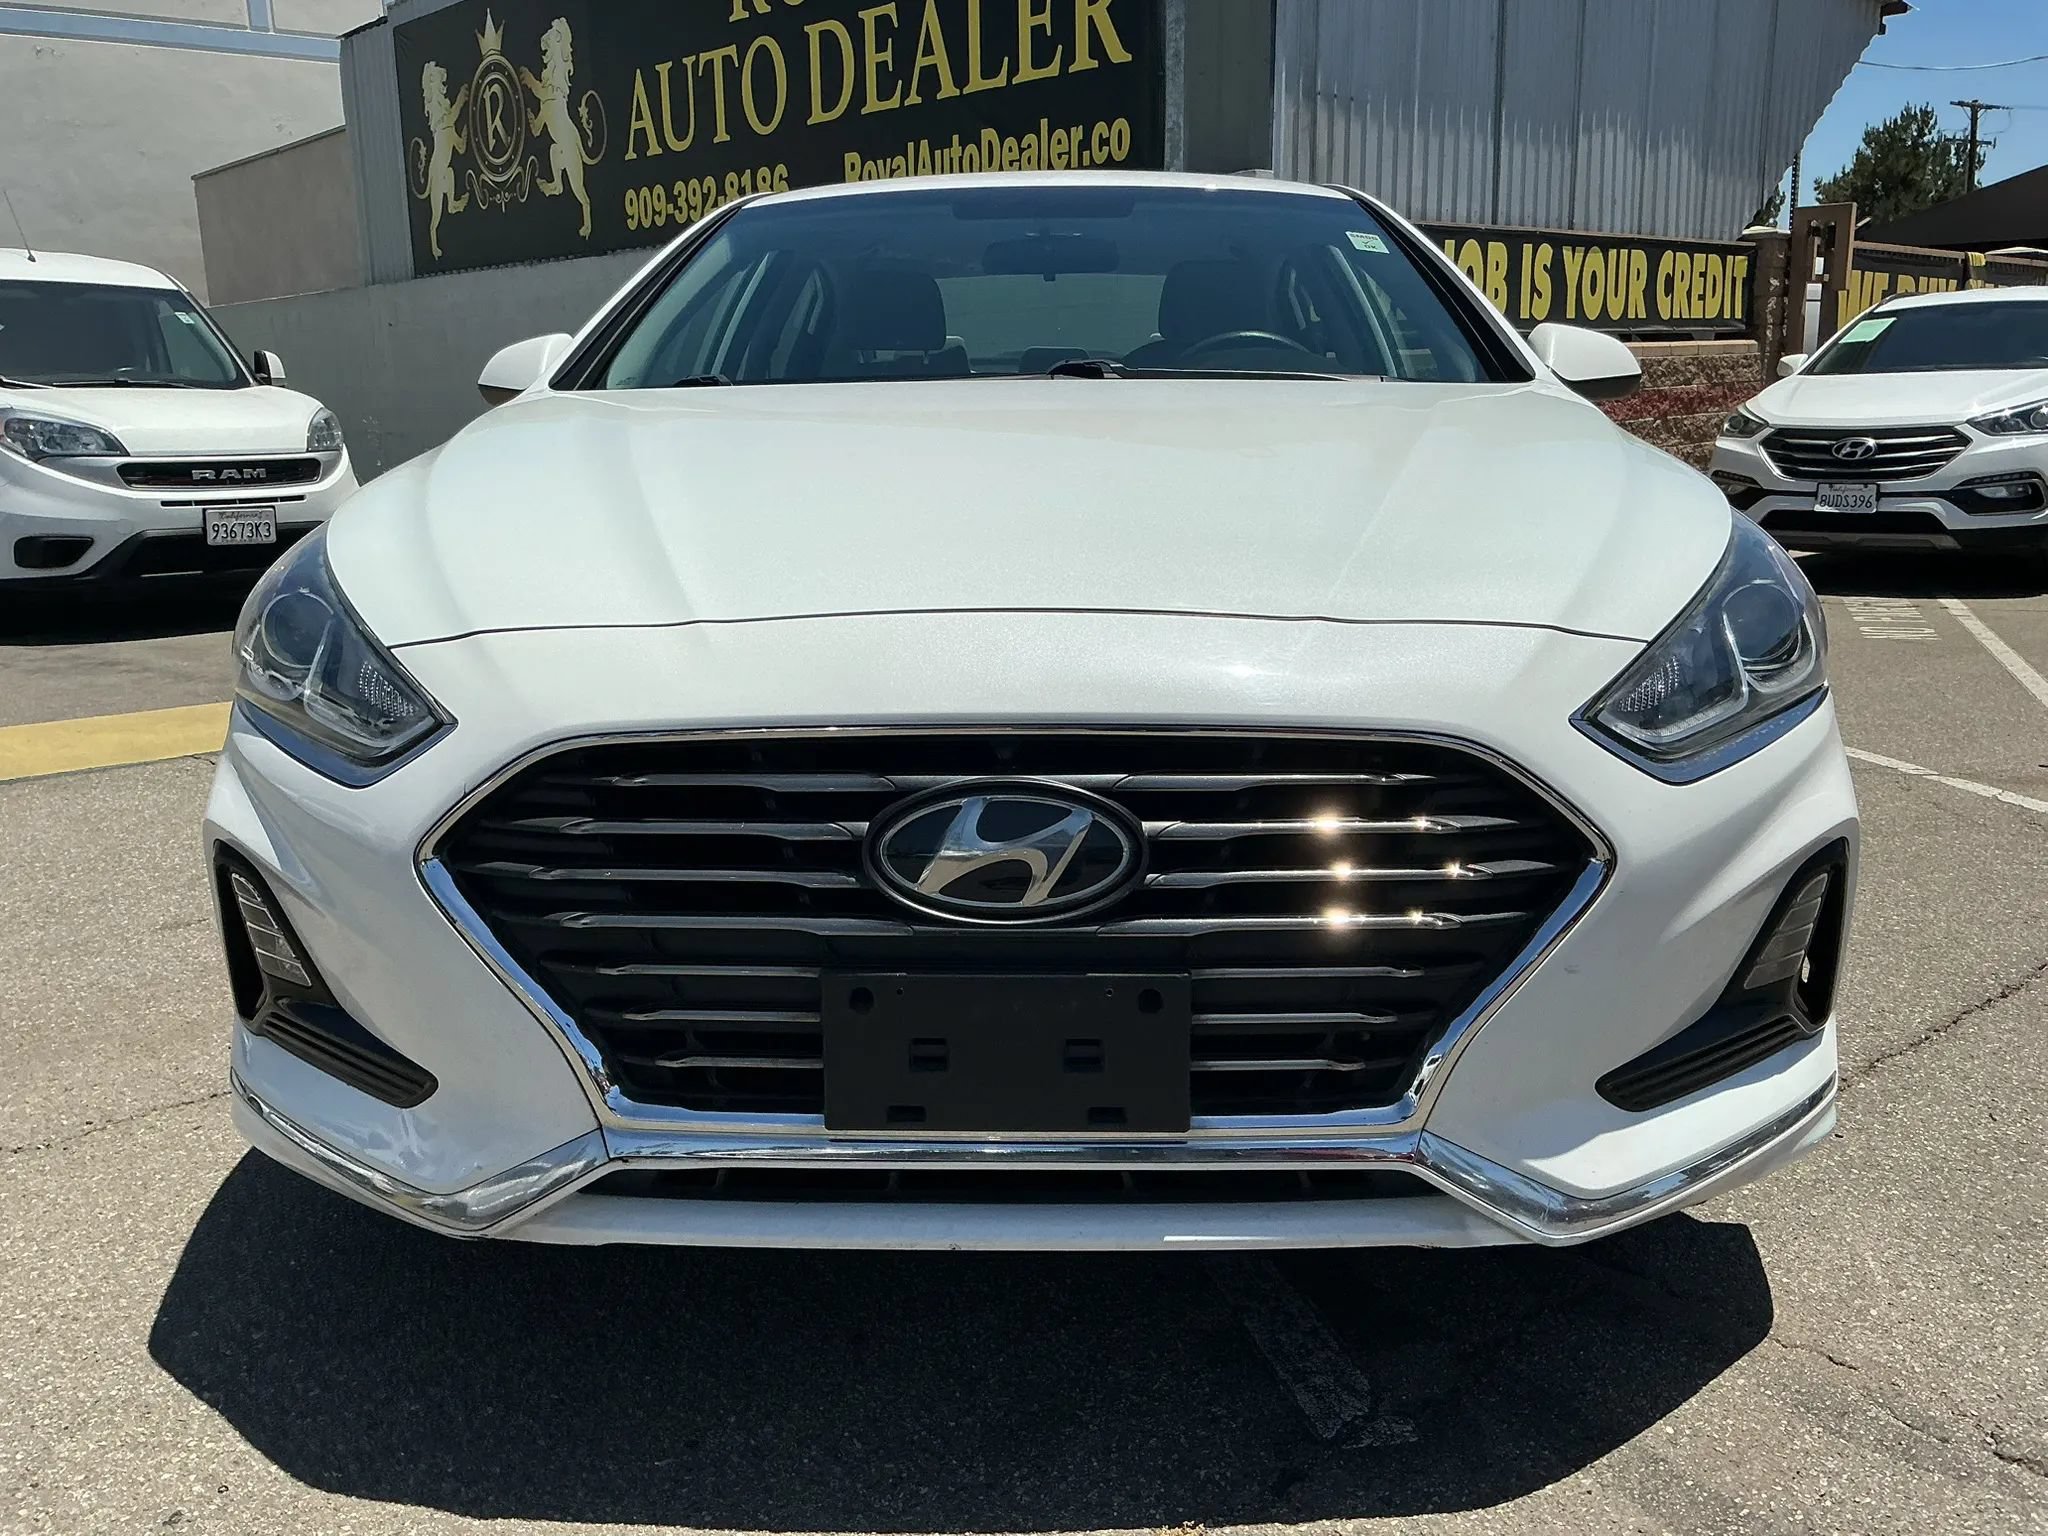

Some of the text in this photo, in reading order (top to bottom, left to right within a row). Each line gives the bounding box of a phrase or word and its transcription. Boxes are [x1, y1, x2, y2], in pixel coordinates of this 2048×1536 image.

[624, 0, 1132, 161] AUTO DEALER
[624, 163, 790, 231] 909-392-8186
[1519, 243, 1553, 321] IS
[1562, 245, 1648, 321] YOUR
[1655, 250, 1749, 321] CREDIT
[191, 468, 267, 480] RAM
[1819, 494, 1874, 509] 8UDS396
[211, 521, 271, 541] 93673K3
